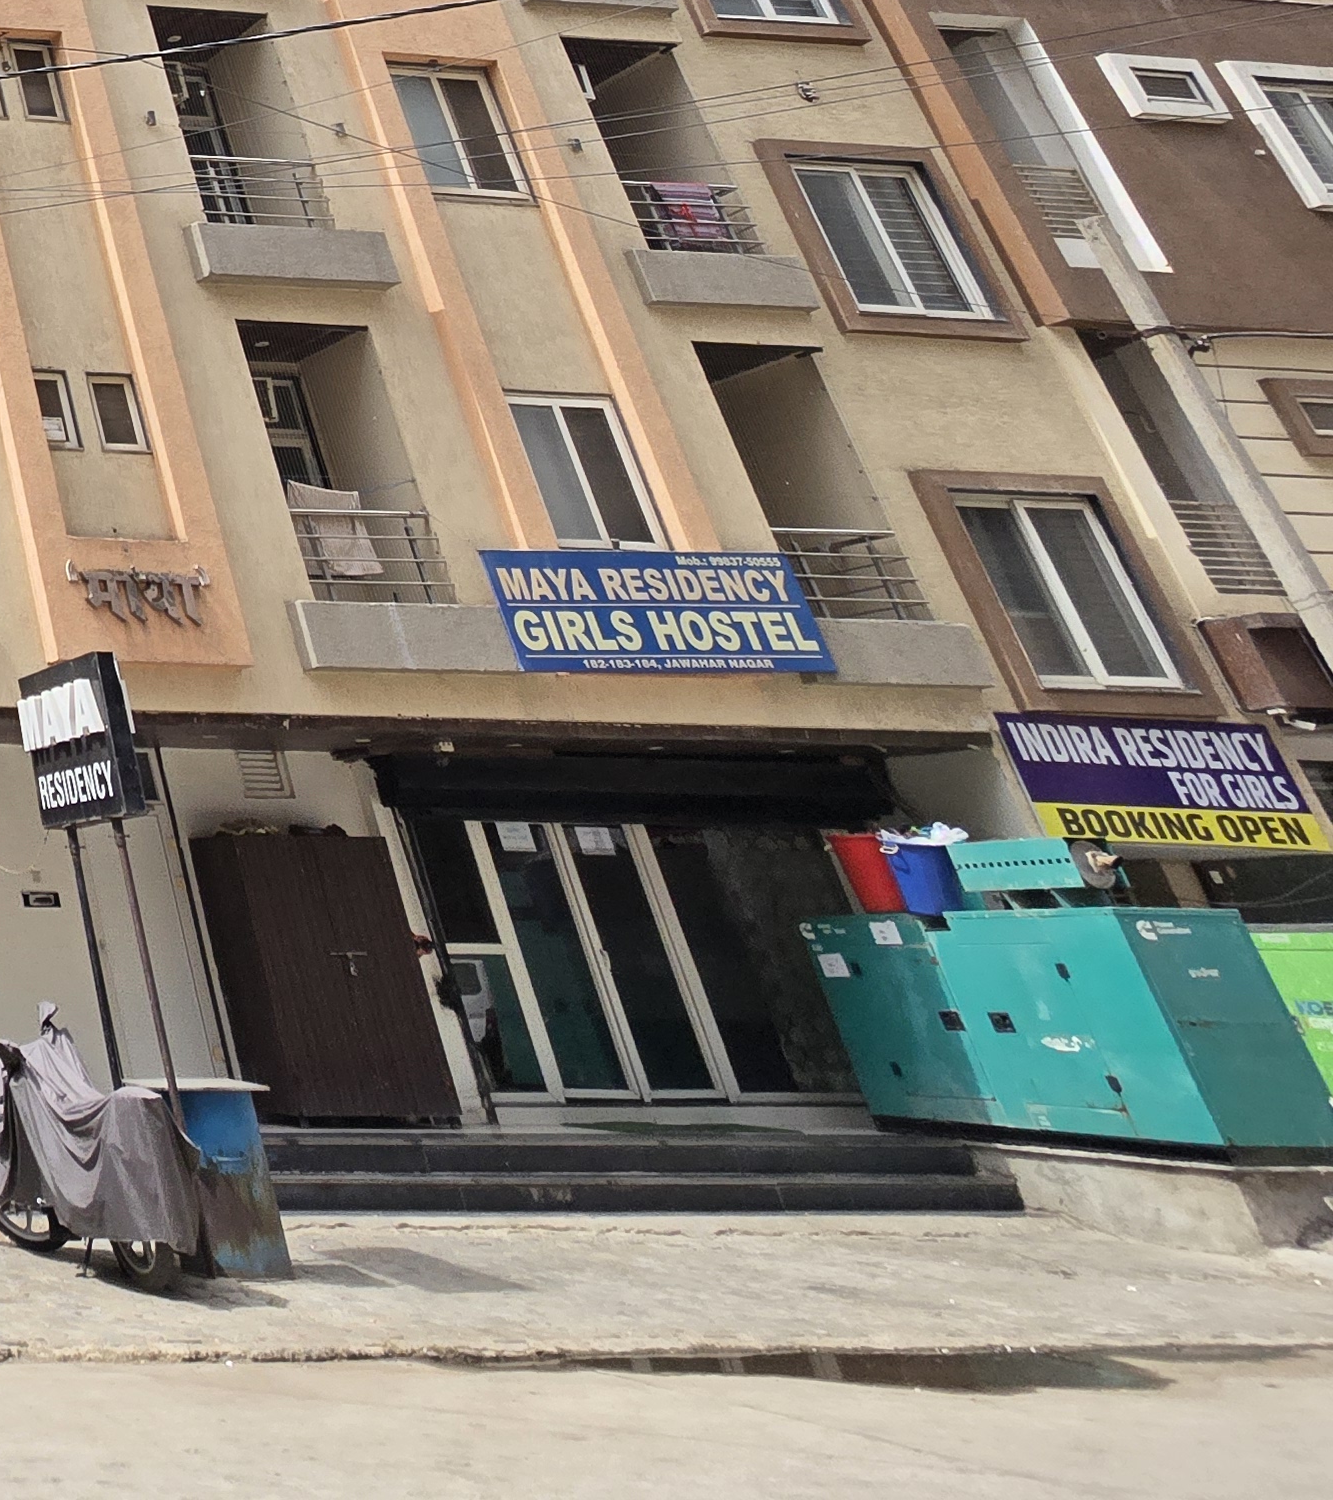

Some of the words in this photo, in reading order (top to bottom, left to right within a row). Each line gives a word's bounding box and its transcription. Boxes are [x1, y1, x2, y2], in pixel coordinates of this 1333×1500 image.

[675, 556, 707, 566] Mob.:
[496, 568, 597, 601] MAYA
[597, 568, 790, 602] RESIDENCY
[514, 611, 643, 651] GIRLS
[646, 611, 819, 652] HOSTEL
[583, 659, 662, 670] 182-183-184,
[664, 659, 727, 669] JAWAHAR
[730, 659, 774, 669] NAGAR
[17, 678, 105, 752] MAYA
[1007, 722, 1120, 765] INDIRA
[1114, 728, 1276, 772] RESIDENCY
[37, 760, 114, 810] RESIDENCY
[1167, 771, 1228, 807] FOR
[1221, 773, 1299, 810] GIRLS
[1057, 808, 1213, 841] BOOKING
[1216, 815, 1311, 846] OPEN
